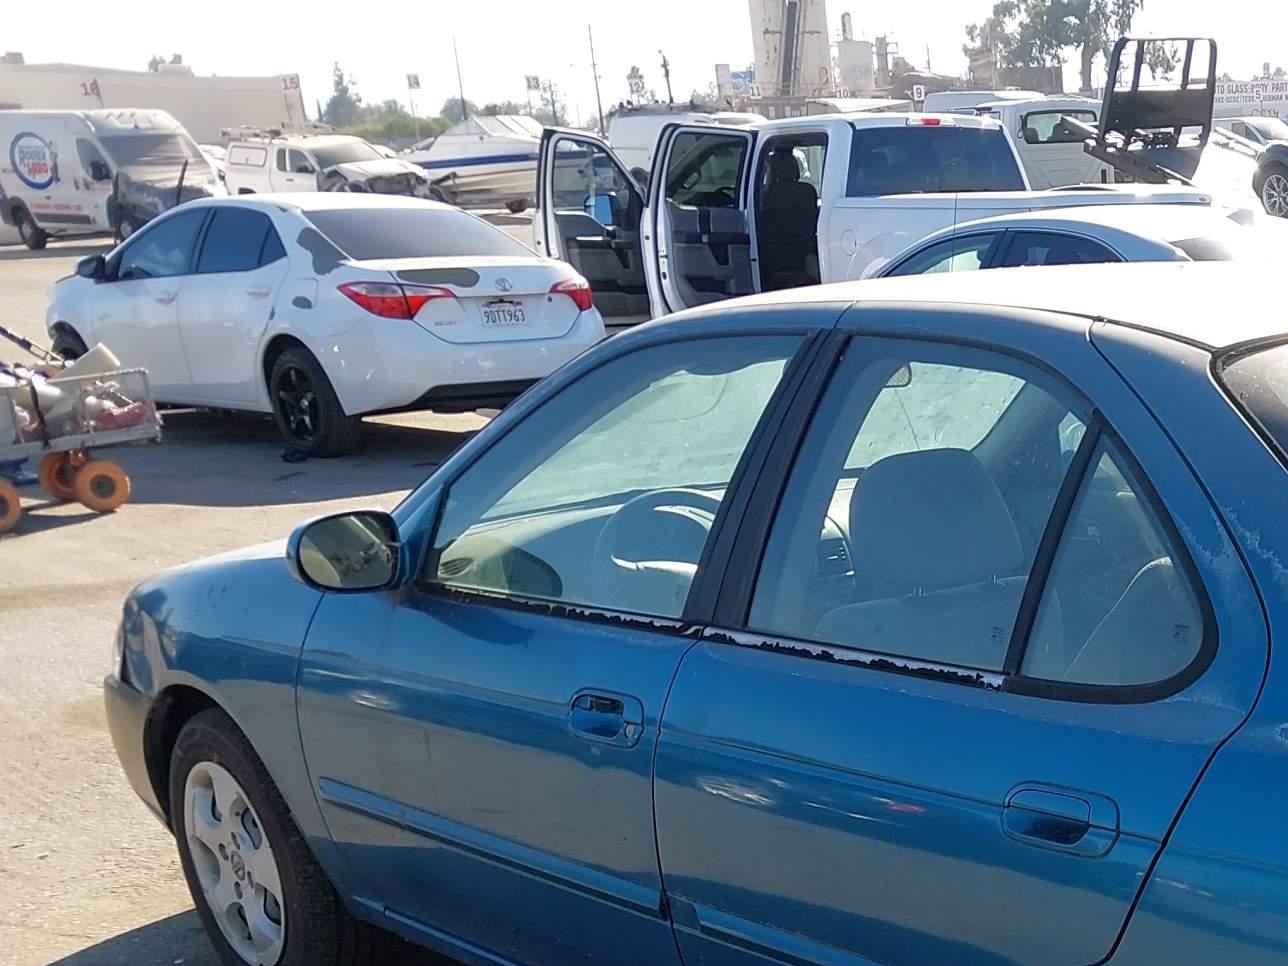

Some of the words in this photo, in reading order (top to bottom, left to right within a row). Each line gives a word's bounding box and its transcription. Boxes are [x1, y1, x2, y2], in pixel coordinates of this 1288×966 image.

[282, 77, 299, 90] 15
[838, 88, 849, 98] 10
[915, 87, 922, 98] 9
[483, 309, 526, 324] 9DTT963
